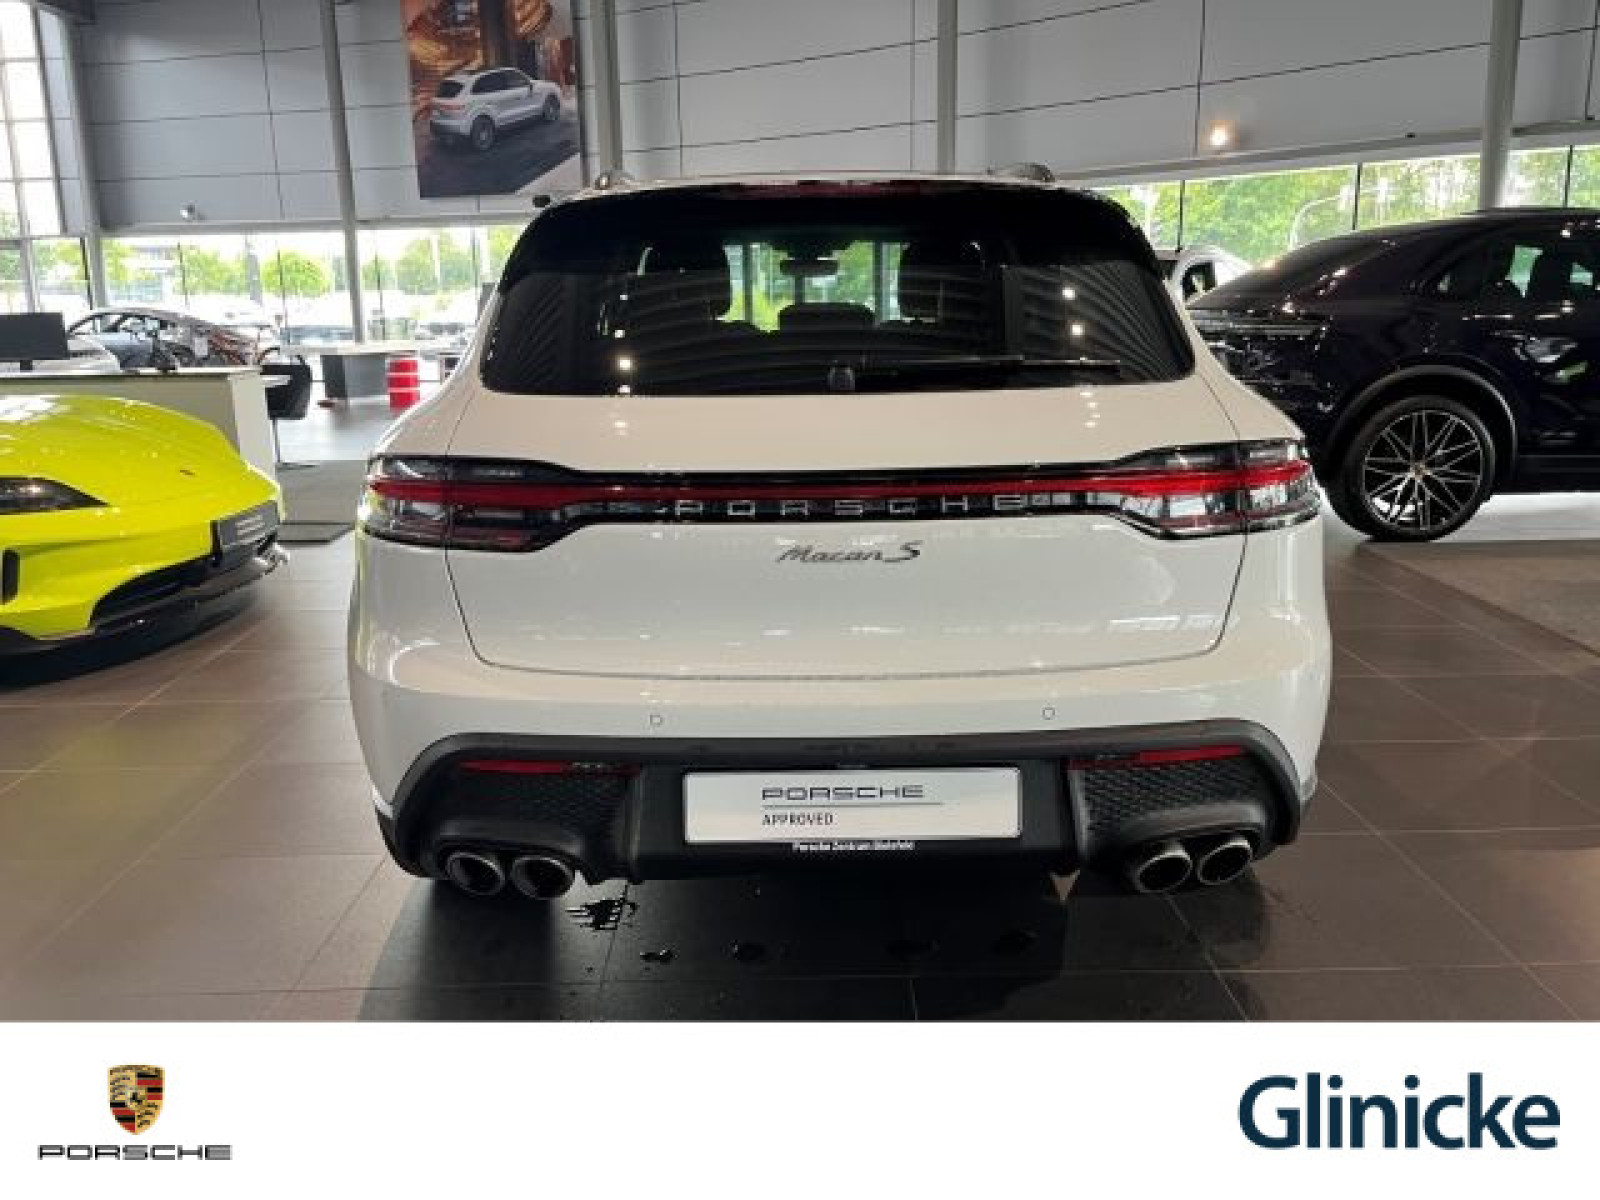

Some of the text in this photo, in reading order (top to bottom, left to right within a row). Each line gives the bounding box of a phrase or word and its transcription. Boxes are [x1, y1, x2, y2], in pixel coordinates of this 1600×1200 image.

[675, 494, 1025, 516] PORSCHE
[776, 540, 923, 563] Macan S
[762, 785, 924, 800] PORSCHE
[762, 812, 834, 826] APPROVED
